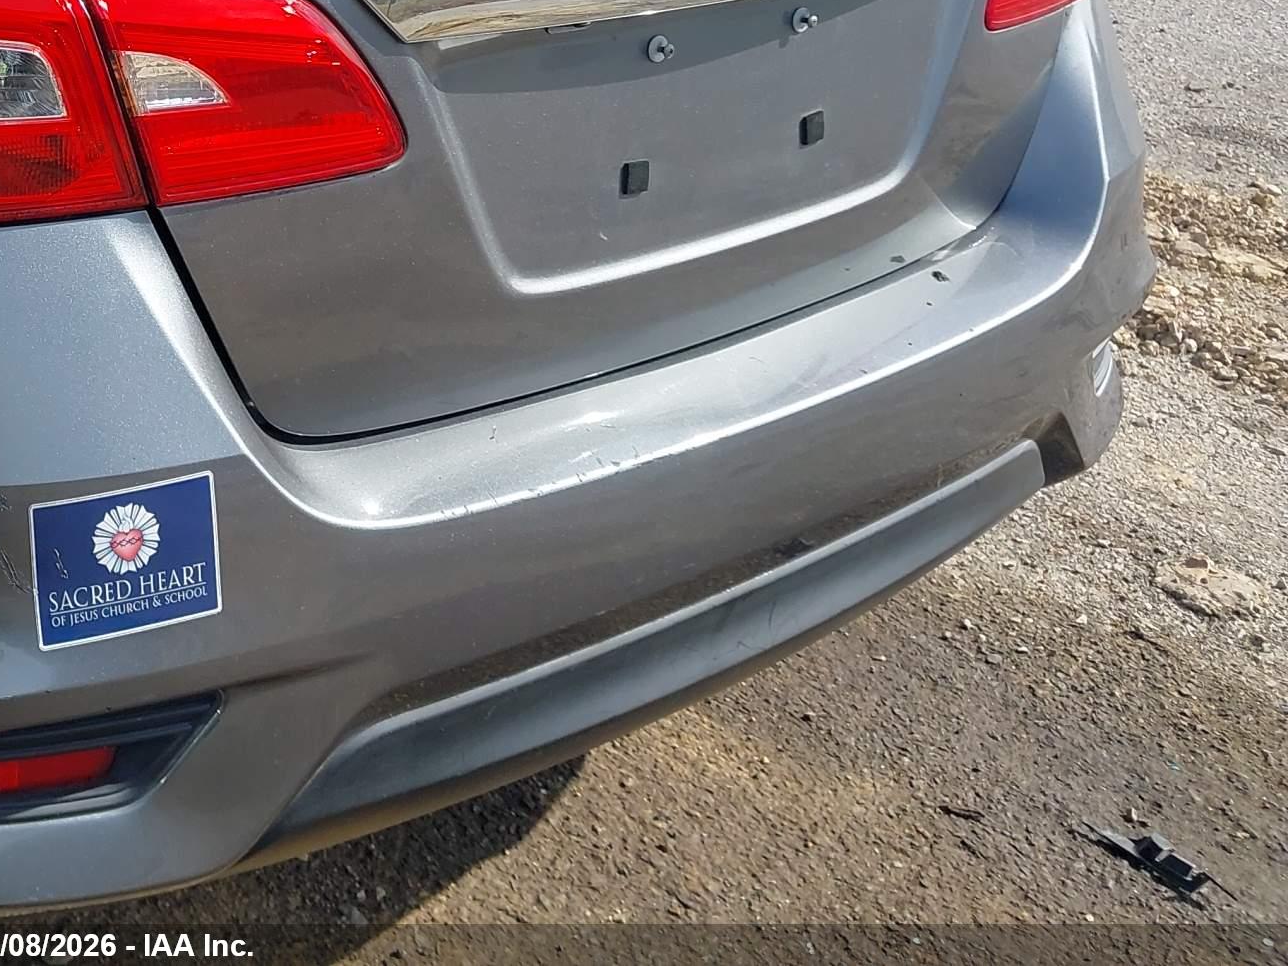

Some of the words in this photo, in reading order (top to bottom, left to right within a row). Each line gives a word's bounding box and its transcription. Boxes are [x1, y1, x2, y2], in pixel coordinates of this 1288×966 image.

[48, 579, 132, 613] SACRED
[139, 562, 206, 595] HEART
[51, 615, 67, 628] OF
[70, 609, 99, 627] JESUS
[101, 599, 150, 619] CHURCH
[152, 596, 162, 608] &
[164, 586, 208, 606] SCHOOL
